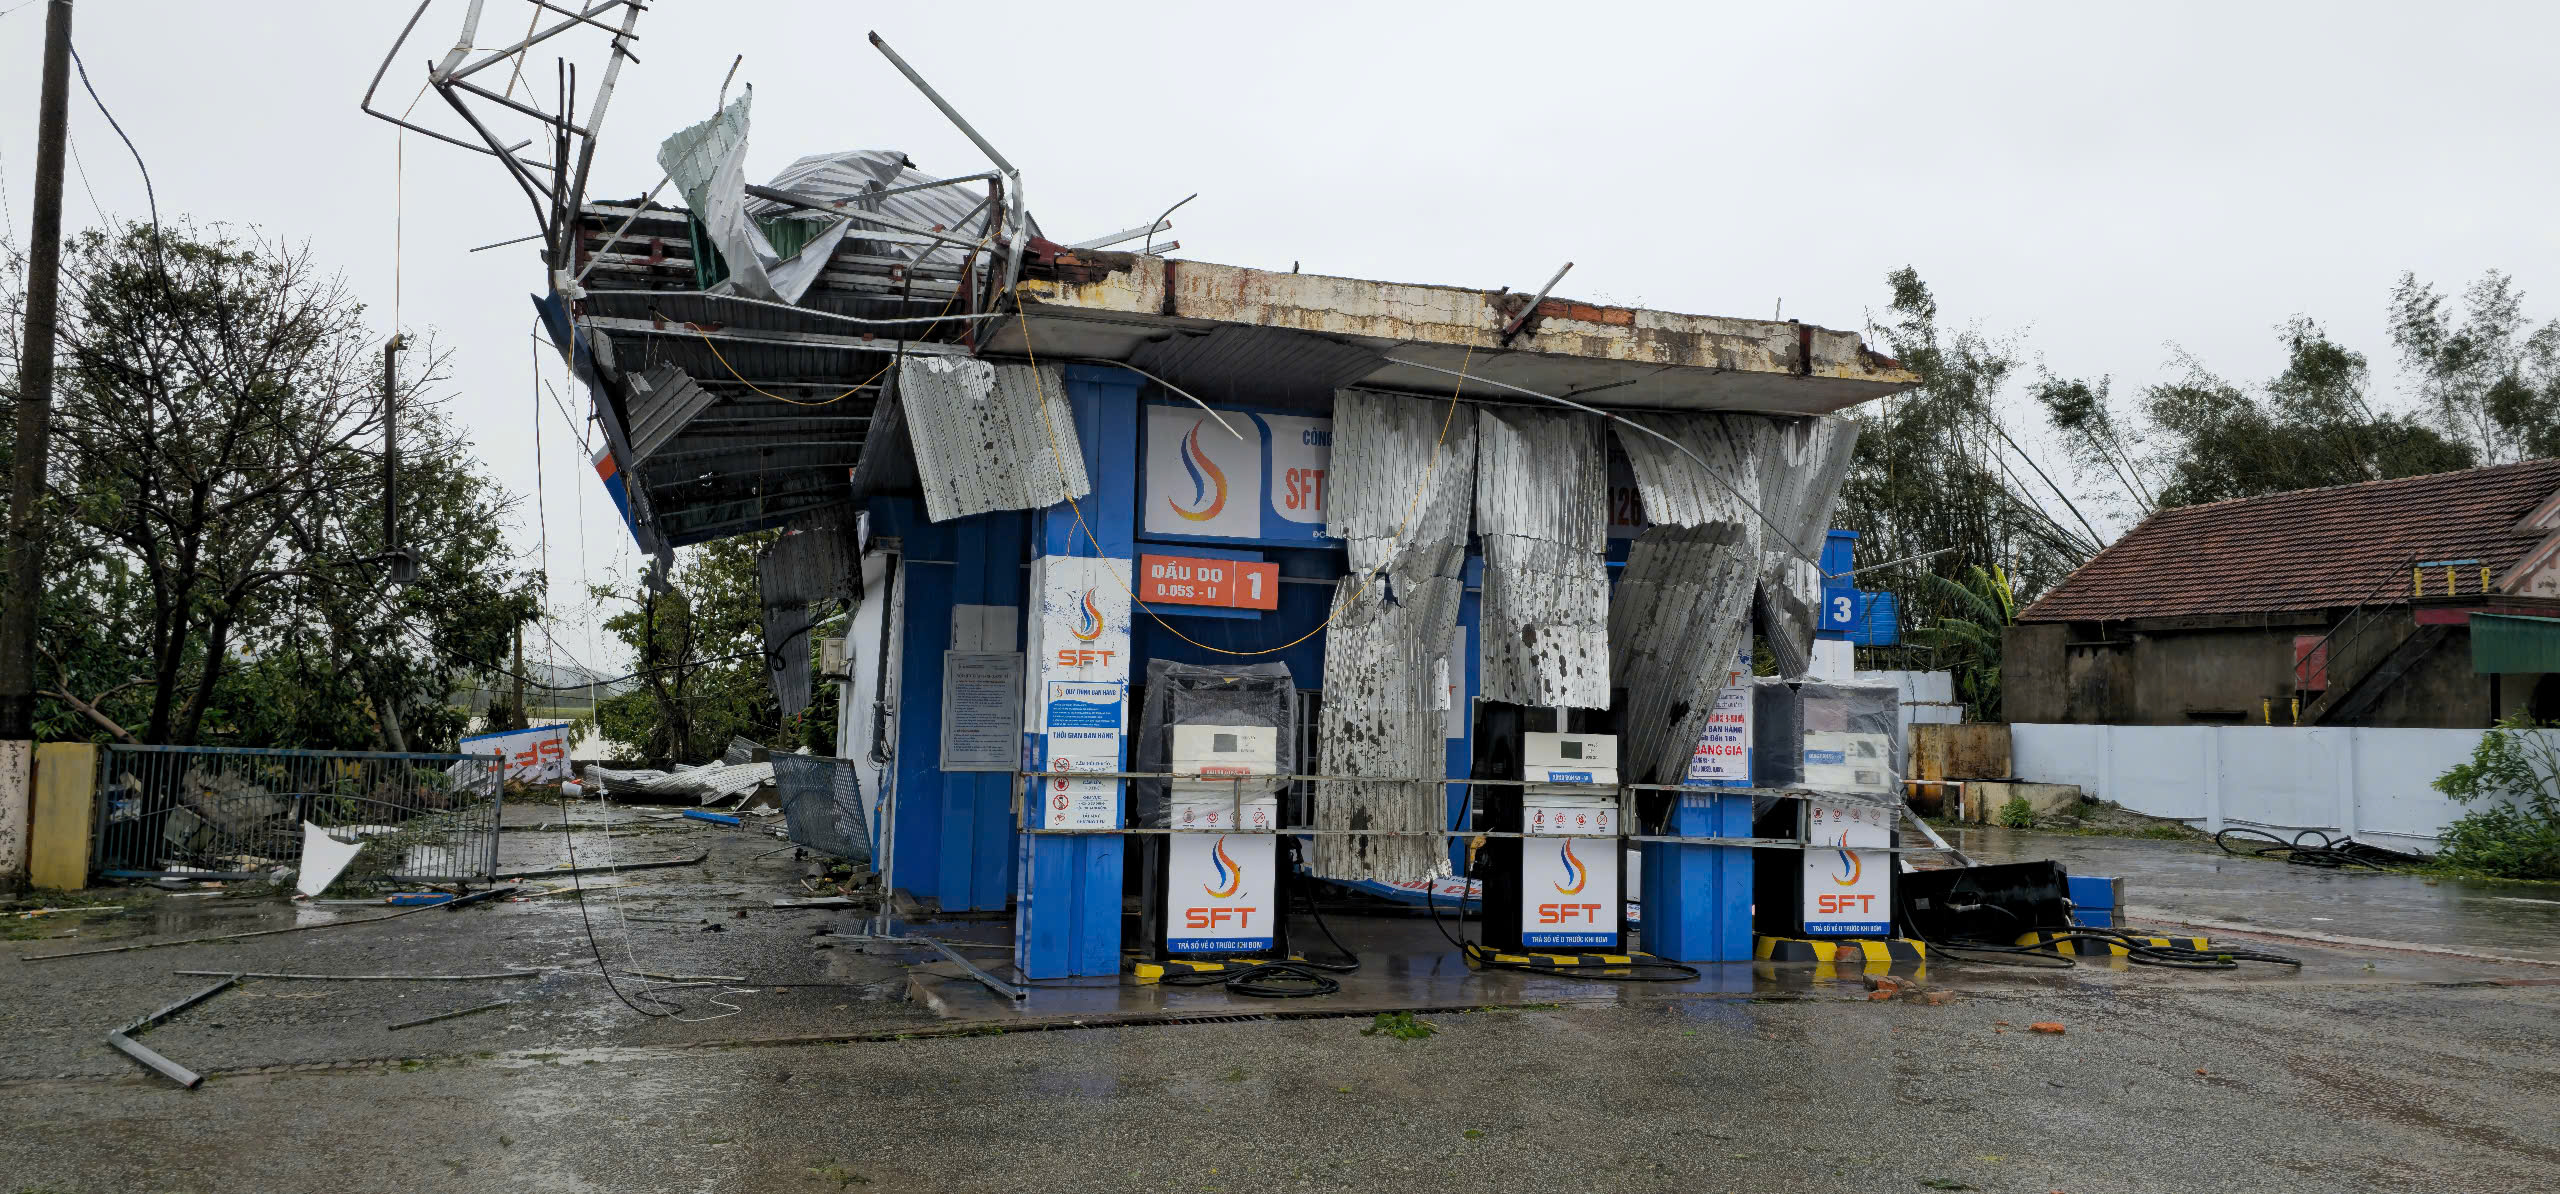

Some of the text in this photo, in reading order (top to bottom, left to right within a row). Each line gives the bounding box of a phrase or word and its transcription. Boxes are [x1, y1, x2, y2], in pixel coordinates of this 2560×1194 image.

[1285, 467, 1325, 511] SFT
[1151, 560, 1223, 583] DẦU DO
[1157, 583, 1195, 598] 0.05S
[1246, 572, 1262, 600] 1
[1833, 596, 1852, 623] 3
[1058, 649, 1115, 667] SFT
[1538, 903, 1602, 924] SFT
[1818, 894, 1876, 914] SFT
[1185, 907, 1257, 929] SFT
